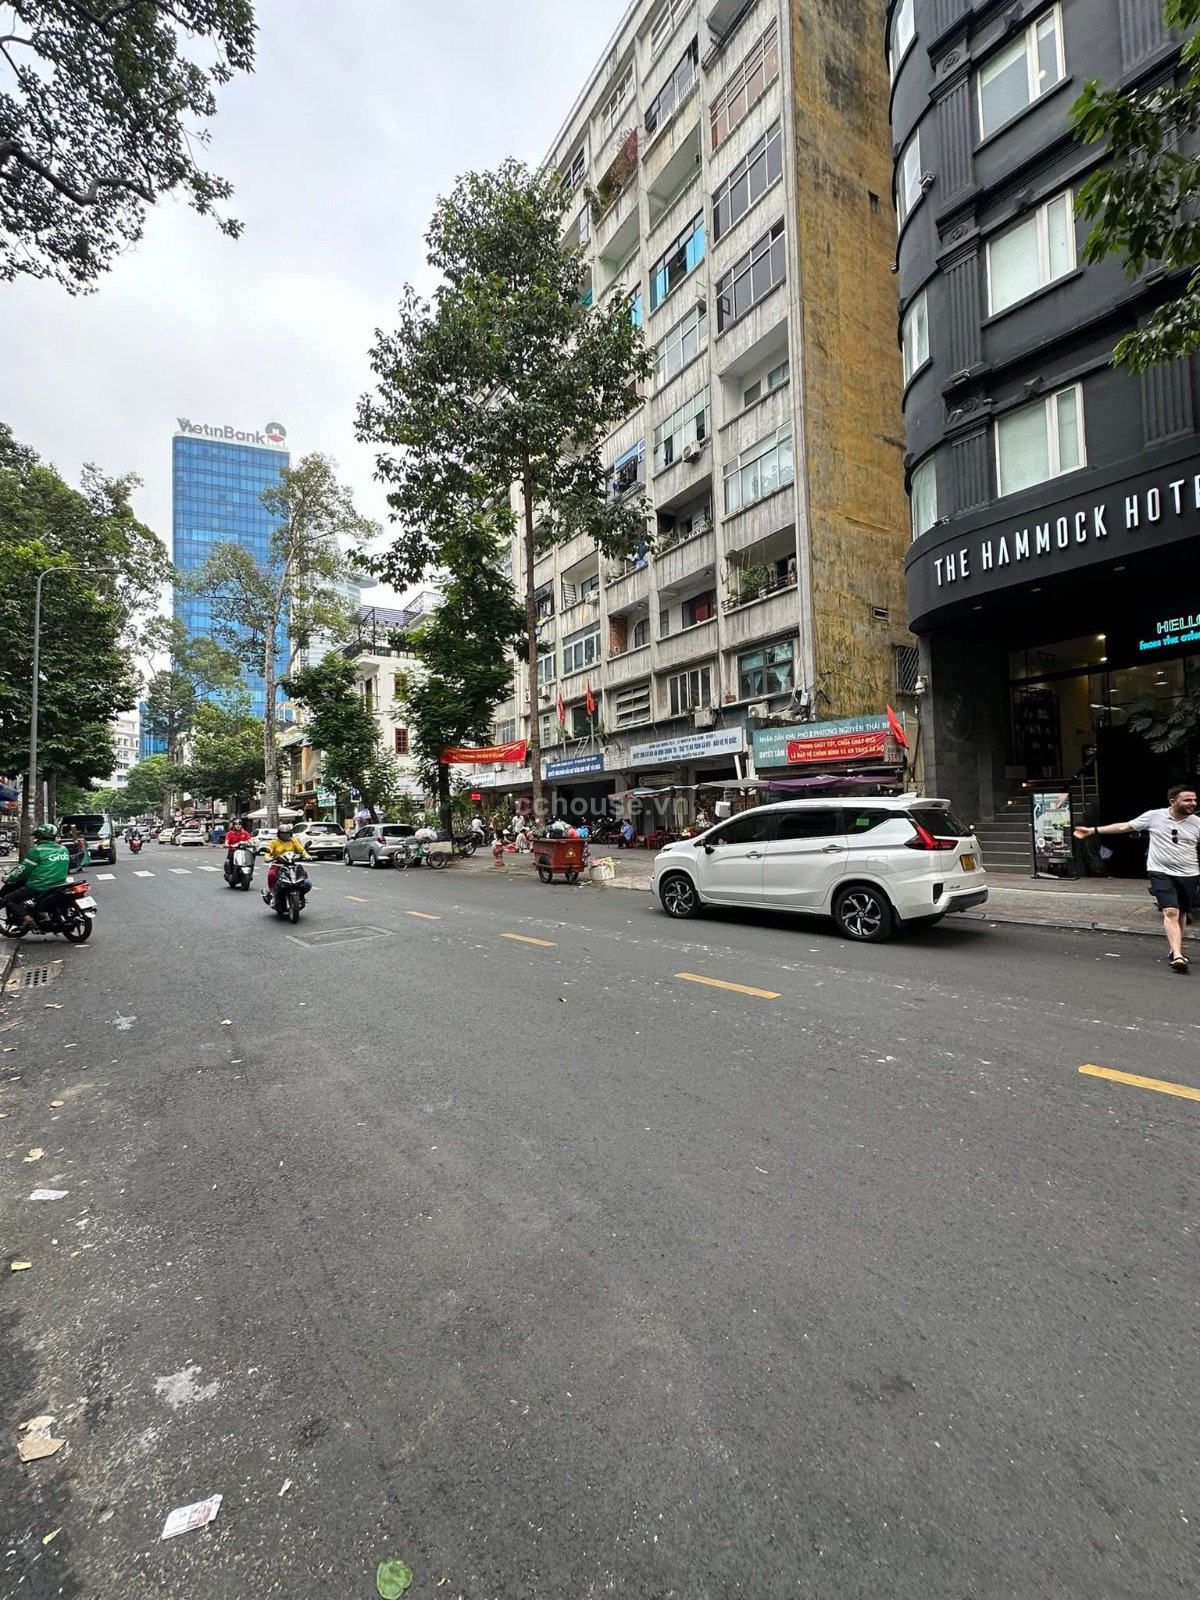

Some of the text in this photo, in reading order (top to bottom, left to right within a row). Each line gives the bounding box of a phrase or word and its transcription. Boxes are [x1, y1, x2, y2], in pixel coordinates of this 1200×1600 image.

[176, 417, 266, 444] VietinBank
[934, 548, 970, 586] THE
[982, 504, 1108, 570] HAMMOCK
[785, 732, 797, 740] KHU
[865, 721, 881, 731] THÁI
[48, 851, 70, 861] Grab
